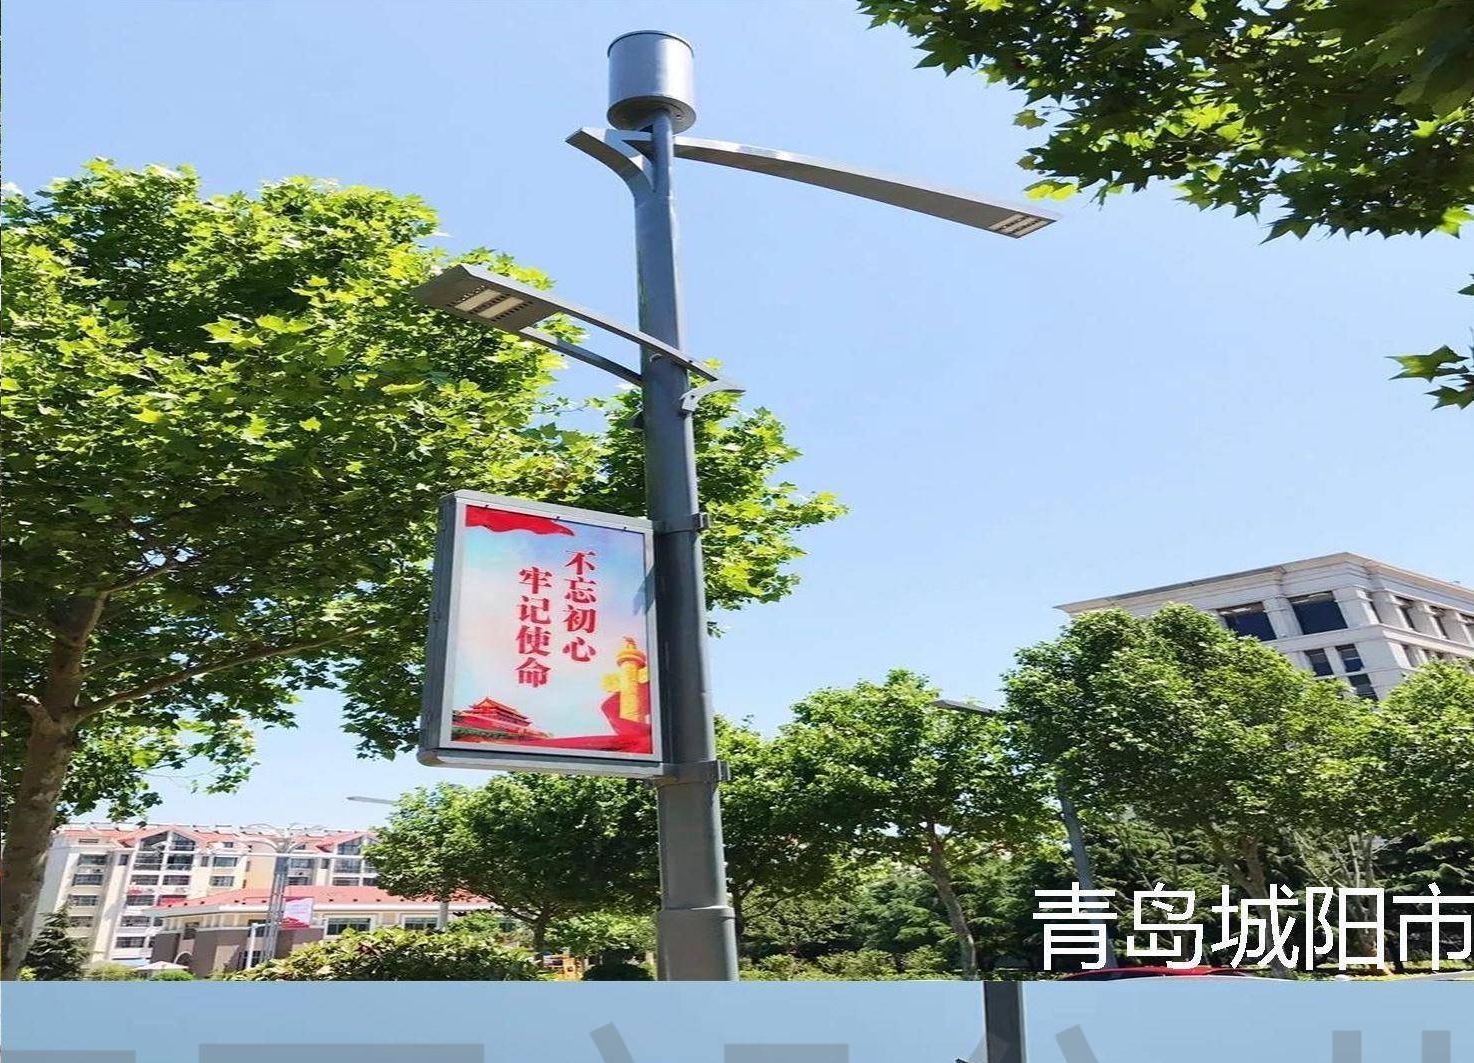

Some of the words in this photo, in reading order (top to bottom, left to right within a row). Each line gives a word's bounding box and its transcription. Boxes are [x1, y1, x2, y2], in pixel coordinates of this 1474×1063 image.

[515, 566, 553, 688] 牢记使命
[562, 549, 597, 663] 不忘初心
